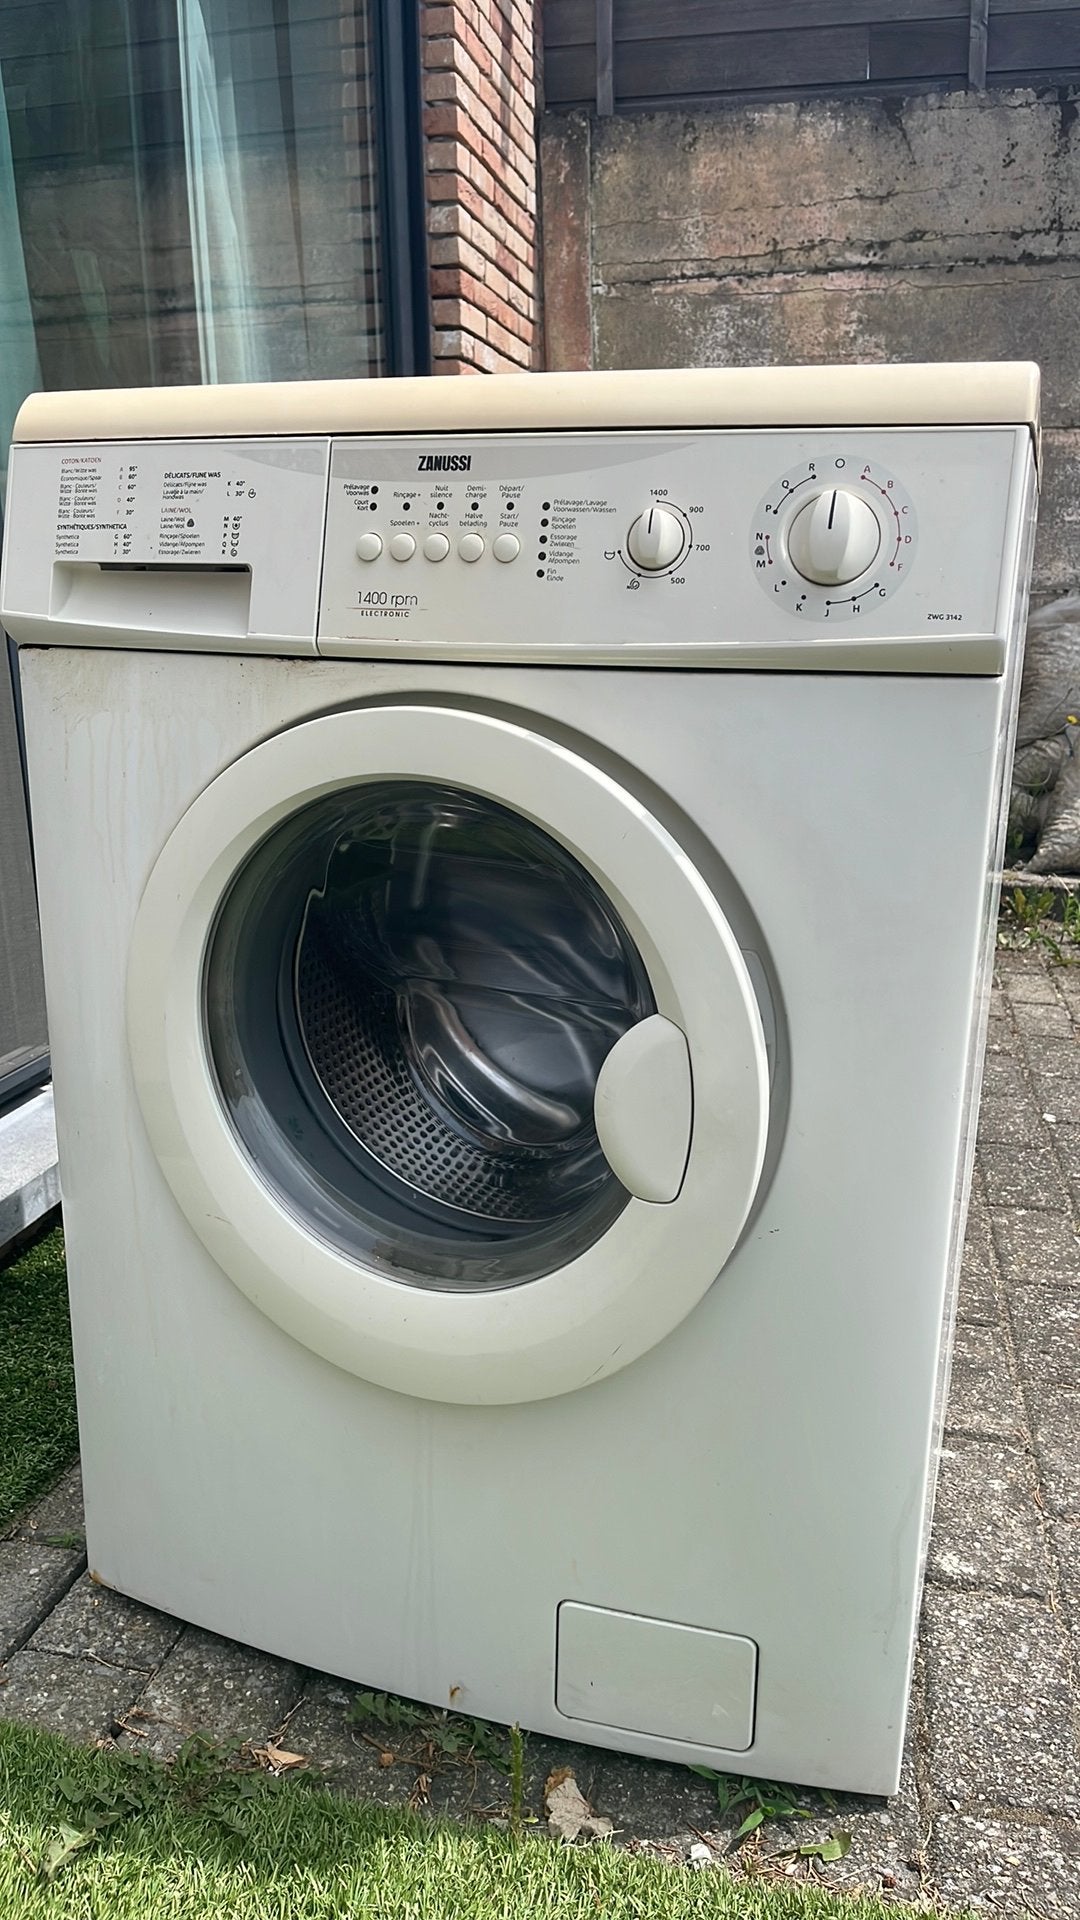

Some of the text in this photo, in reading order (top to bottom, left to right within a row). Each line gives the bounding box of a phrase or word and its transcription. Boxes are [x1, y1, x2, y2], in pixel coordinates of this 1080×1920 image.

[418, 455, 472, 471] ZANUSSI
[781, 480, 790, 489] Q
[902, 506, 908, 514] C
[460, 520, 488, 528] belading
[756, 533, 763, 541] N
[756, 560, 766, 568] M
[774, 584, 780, 592] L
[879, 589, 886, 597] G
[357, 591, 418, 608] 1400 rpm
[825, 609, 830, 617] J
[853, 605, 860, 613] H
[361, 610, 410, 618] ELECTRONIC
